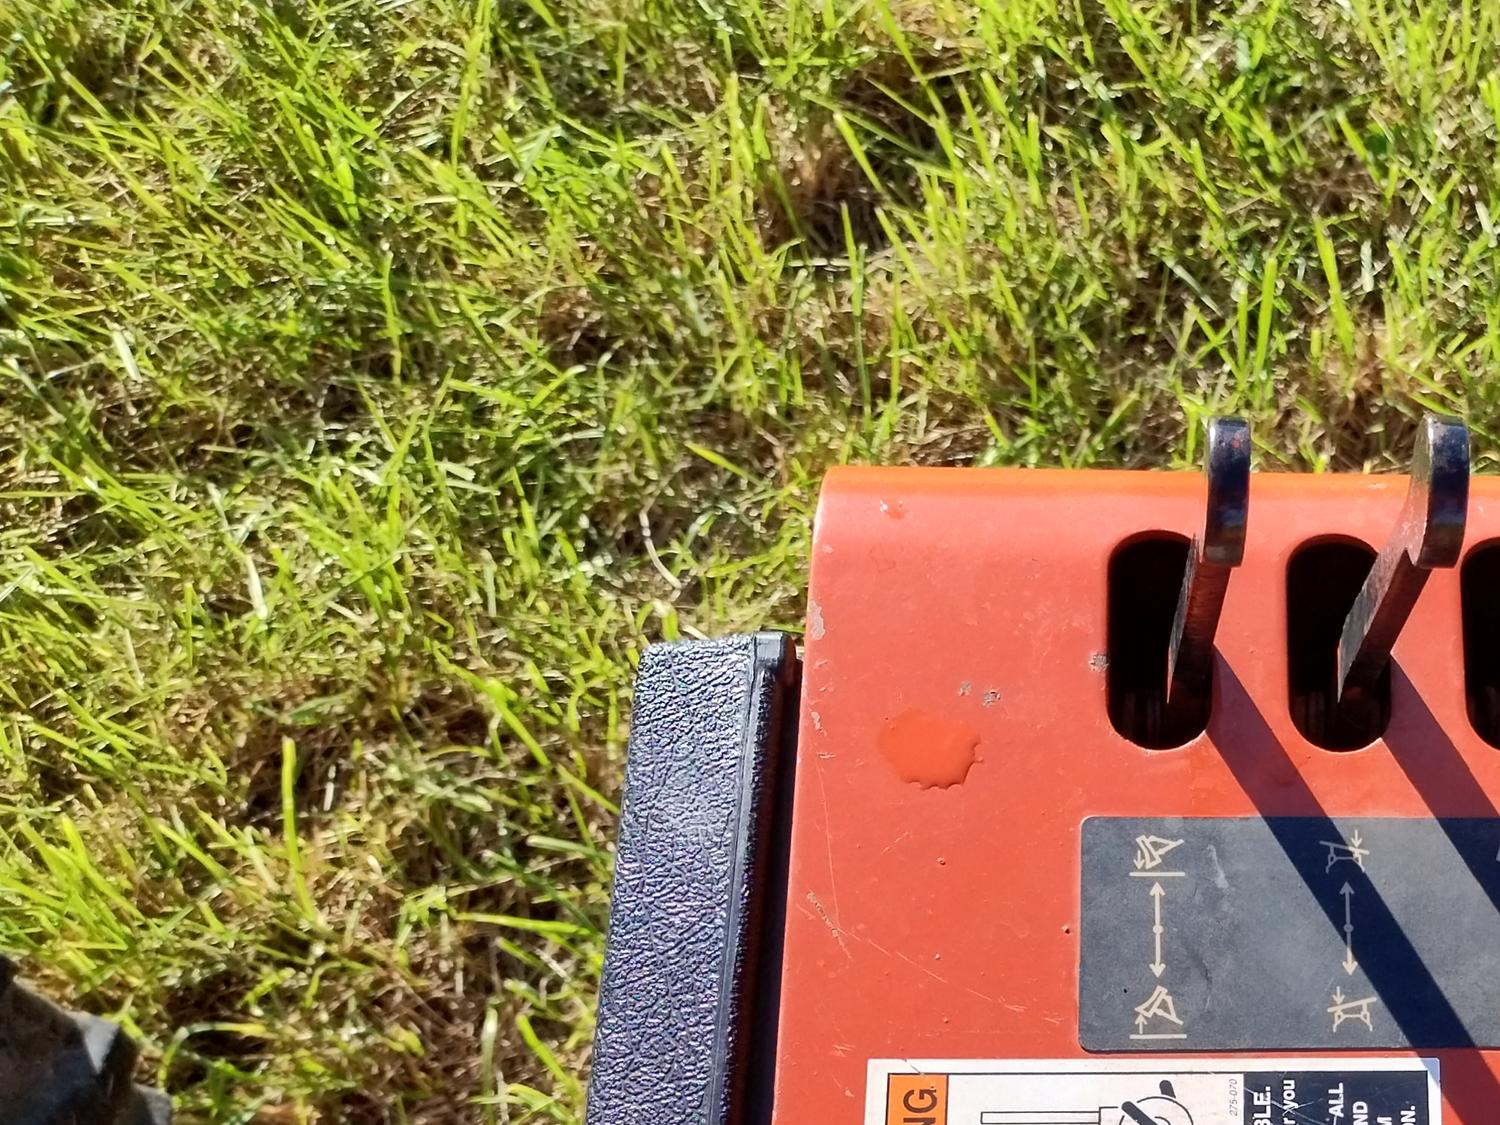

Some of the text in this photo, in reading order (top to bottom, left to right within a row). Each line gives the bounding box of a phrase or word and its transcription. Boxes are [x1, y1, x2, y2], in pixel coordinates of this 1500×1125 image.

[1228, 1078, 1239, 1117] 275-070
[1282, 1079, 1299, 1112] you
[1328, 1082, 1344, 1118] ALL
